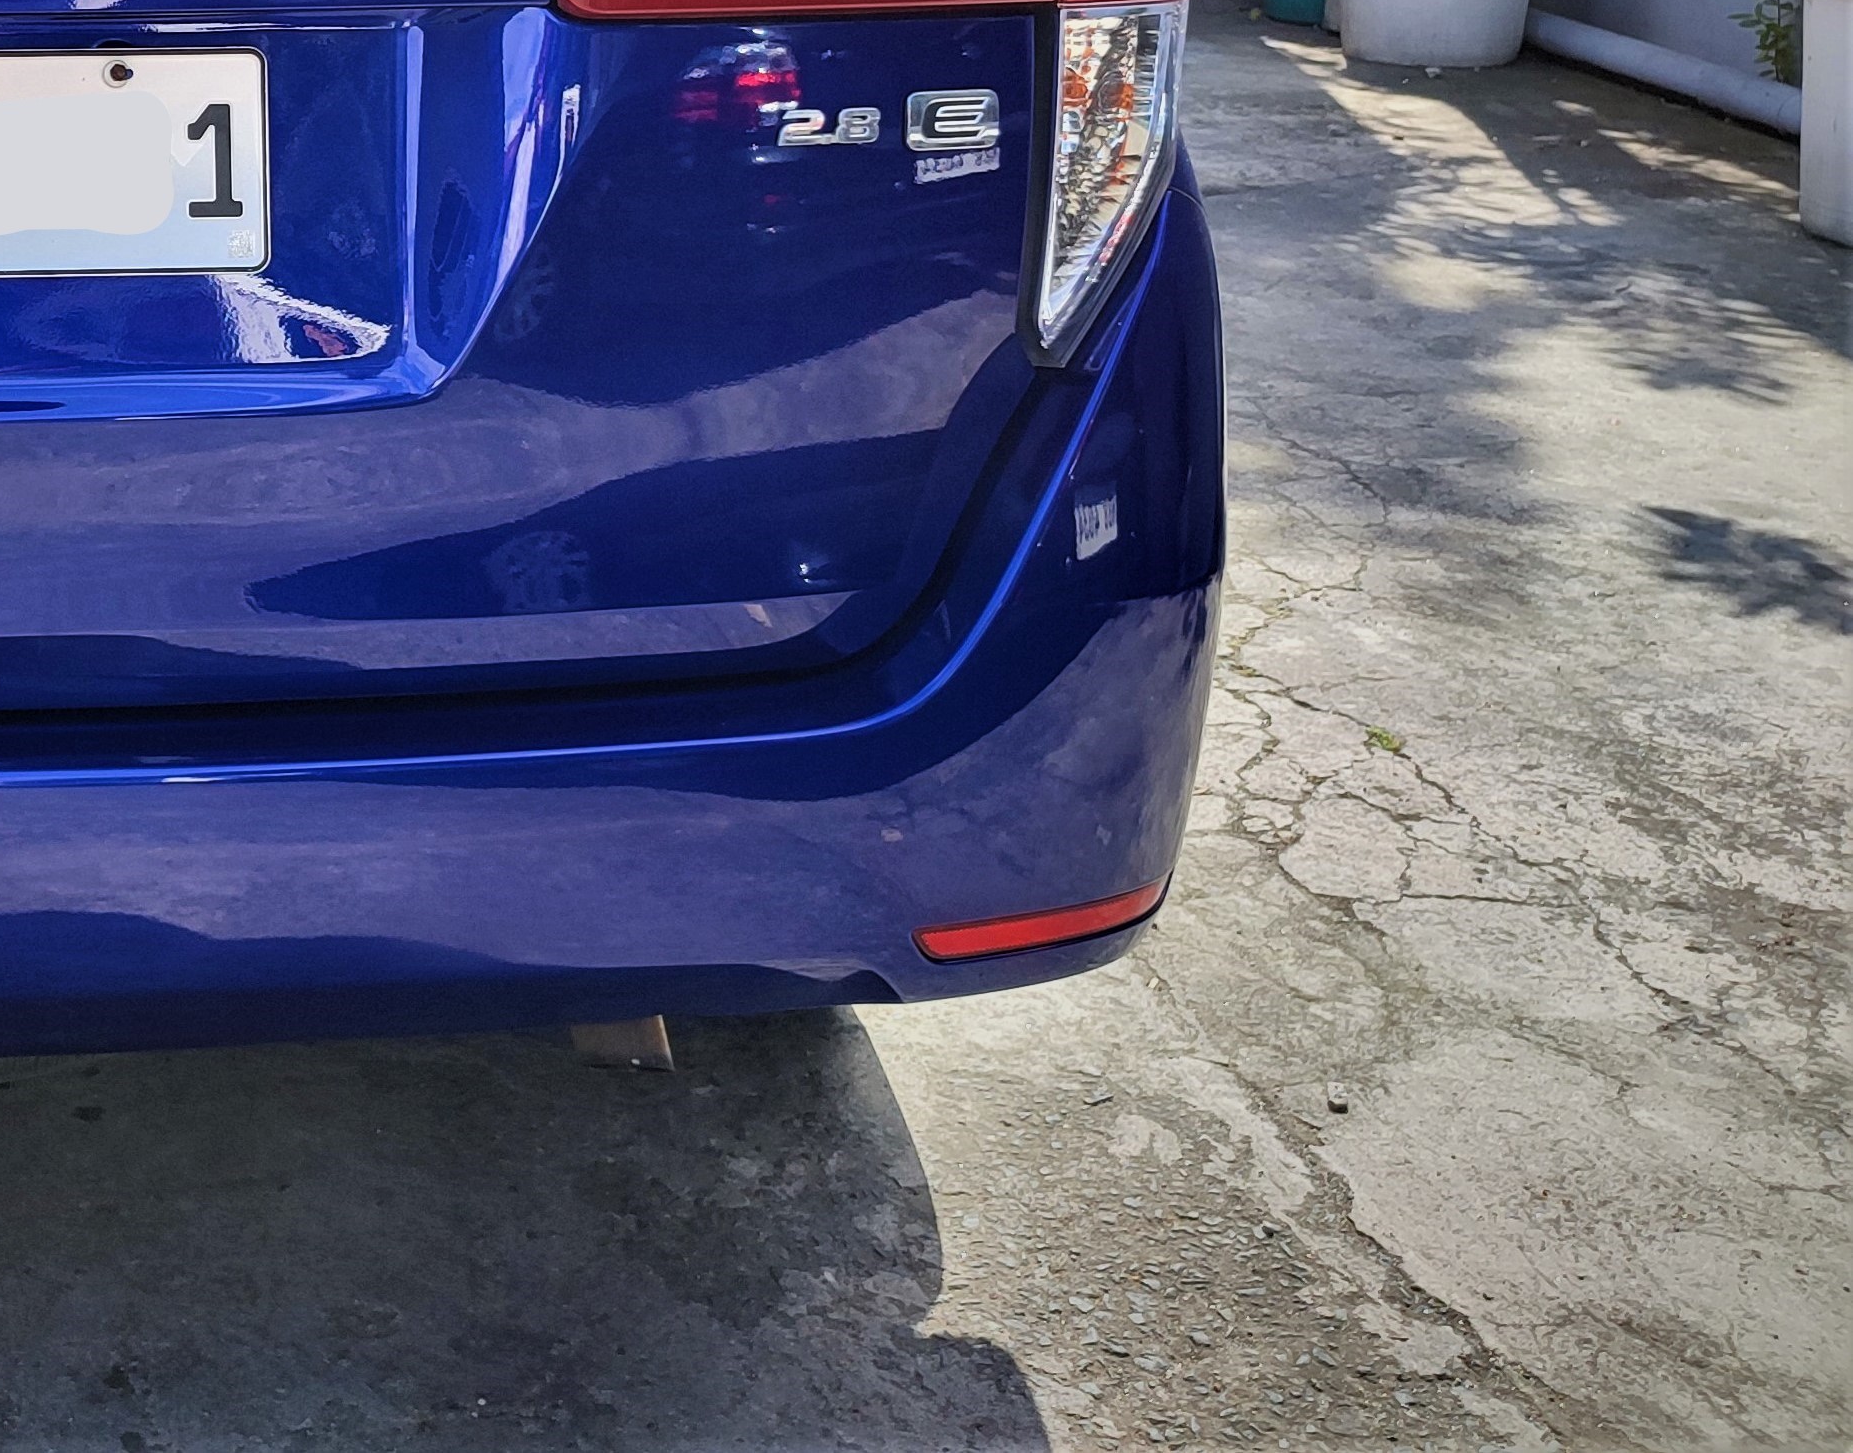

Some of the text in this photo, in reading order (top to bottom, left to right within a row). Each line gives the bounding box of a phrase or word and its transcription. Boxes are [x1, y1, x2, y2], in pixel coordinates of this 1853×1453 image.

[187, 103, 244, 218] 1
[778, 93, 994, 146] 2.8 E
